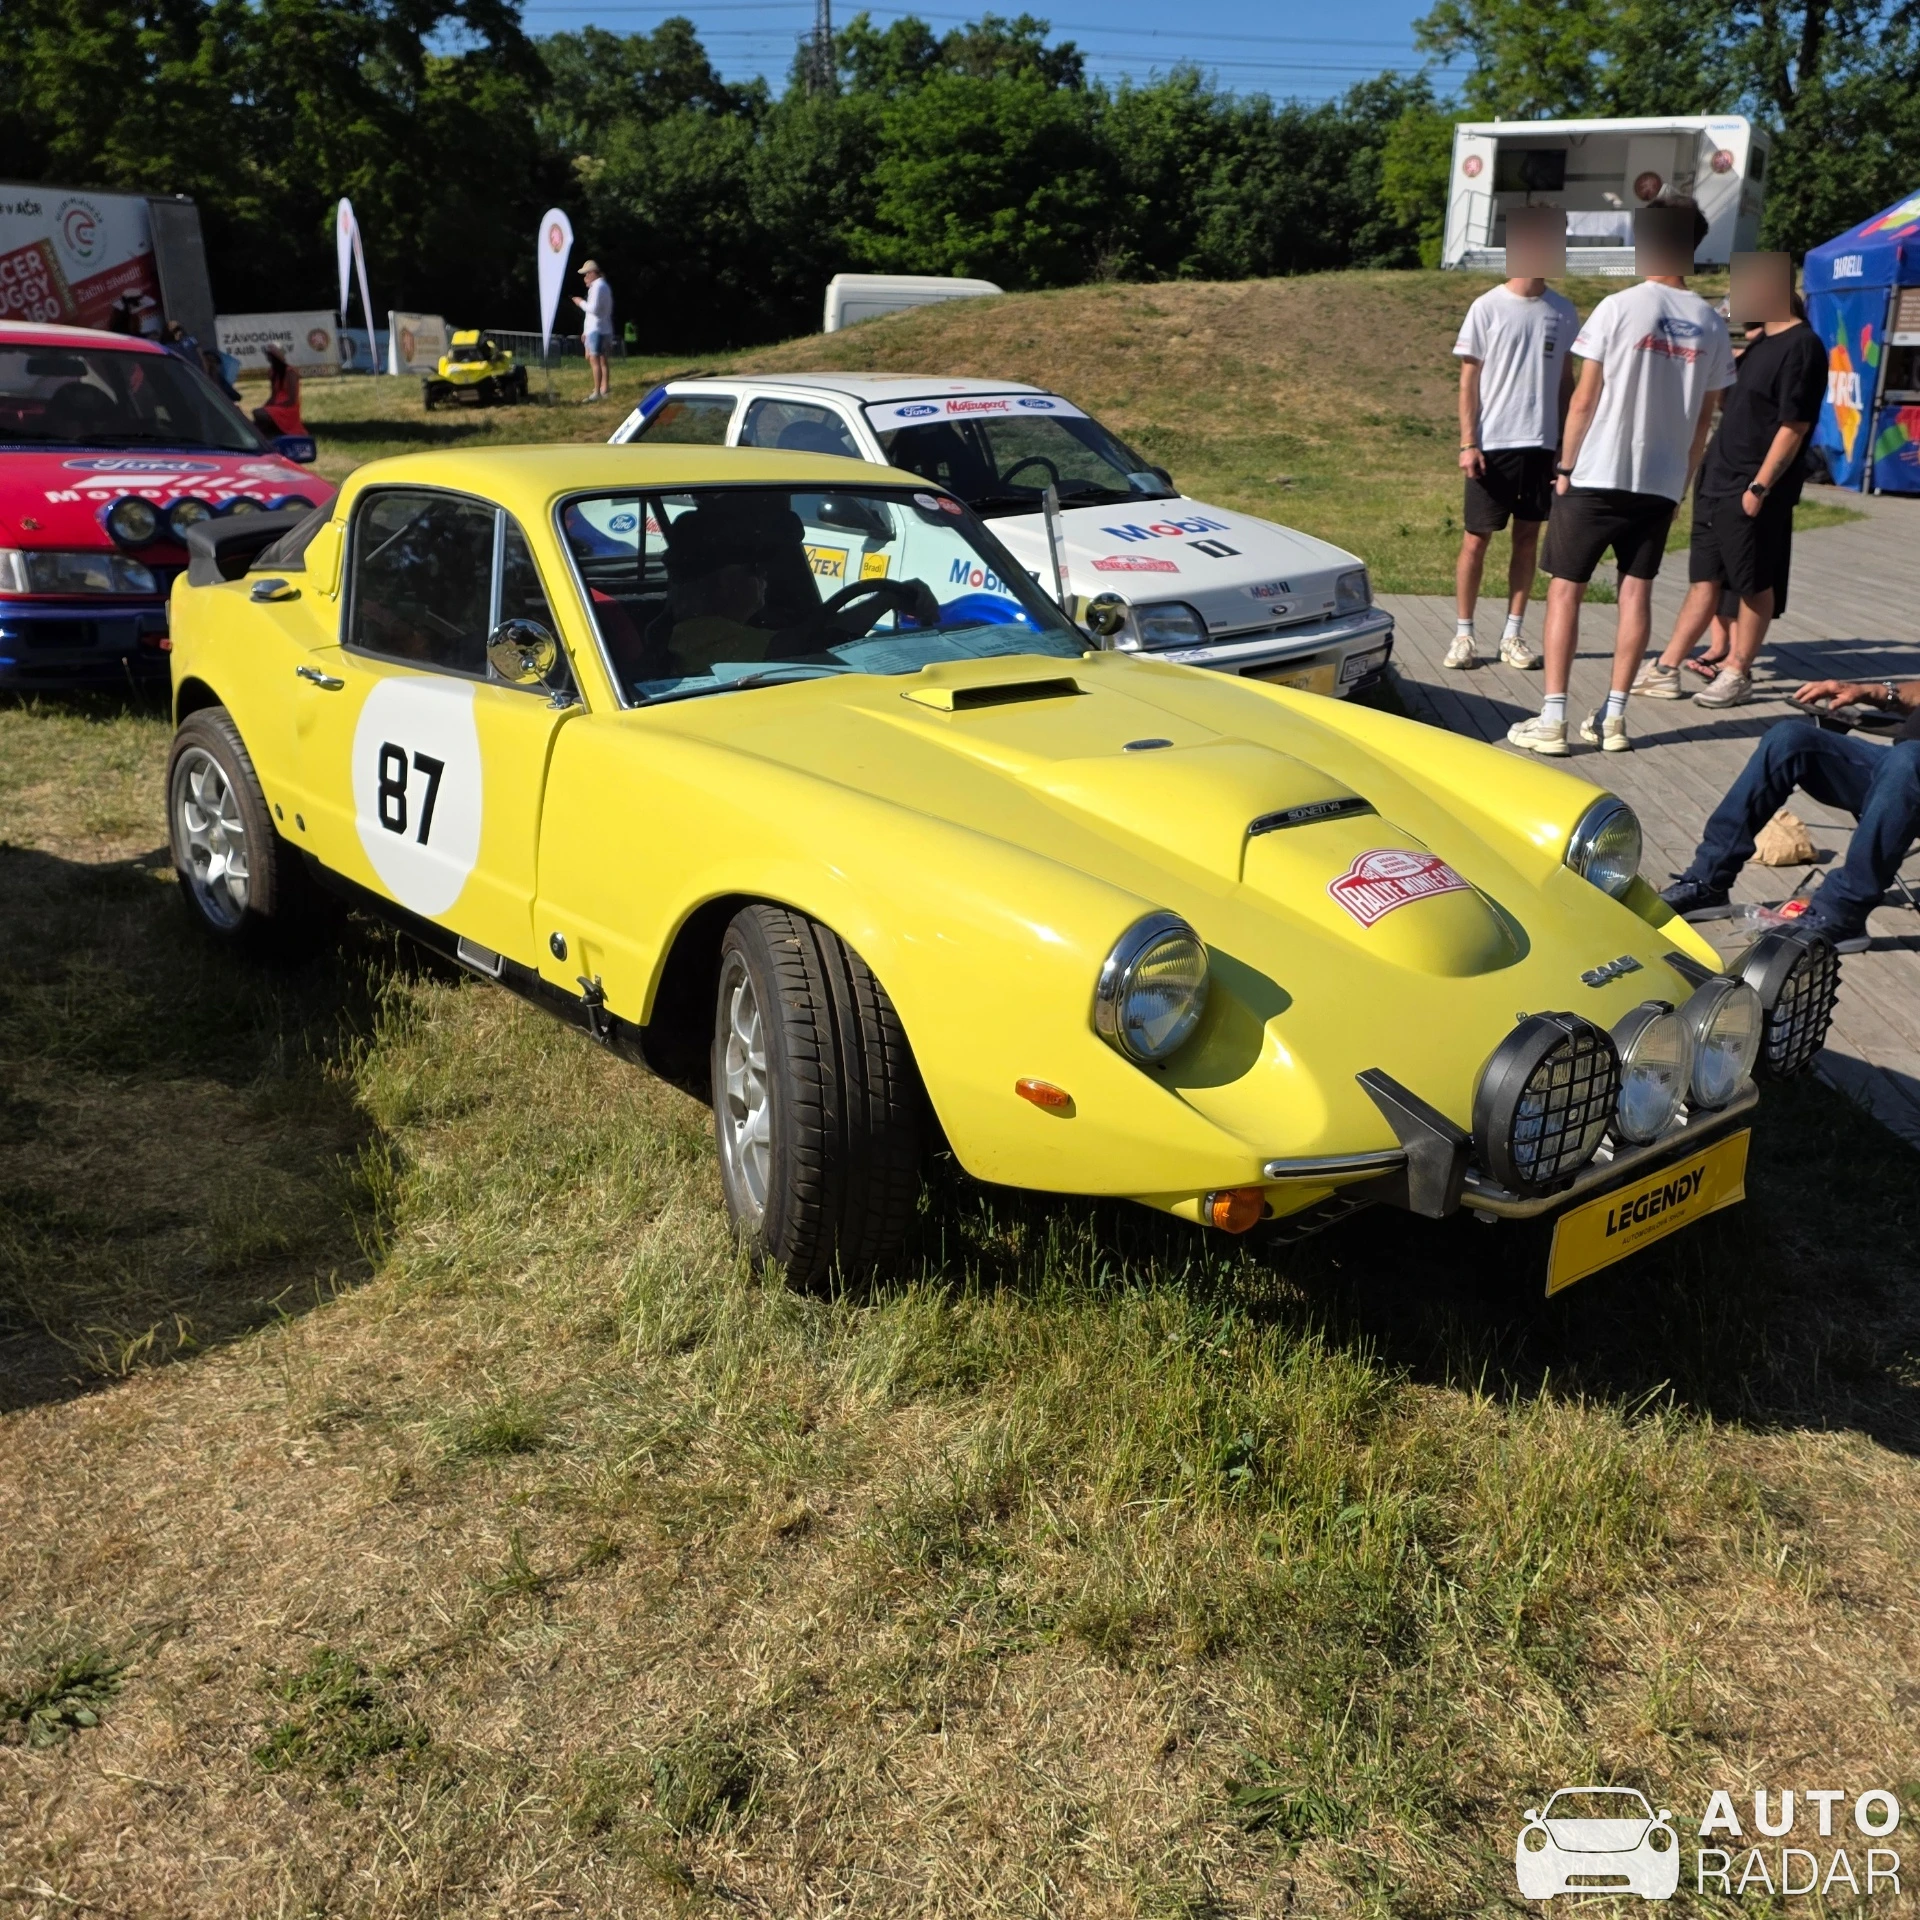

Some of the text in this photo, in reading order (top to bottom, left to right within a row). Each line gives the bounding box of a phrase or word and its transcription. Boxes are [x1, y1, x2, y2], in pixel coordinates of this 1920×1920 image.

[0, 250, 44, 286] CER
[1663, 320, 1697, 336] Ford
[946, 400, 1011, 414] Motorsport
[91, 458, 197, 472] Ford
[611, 515, 634, 530] Ford
[1099, 516, 1232, 543] Mobil
[1250, 584, 1280, 598] Mobil
[377, 741, 446, 846] 87
[1340, 879, 1407, 918] RALLYE
[1580, 954, 1640, 986] SAAB
[1605, 1165, 1706, 1238] LEGENDY
